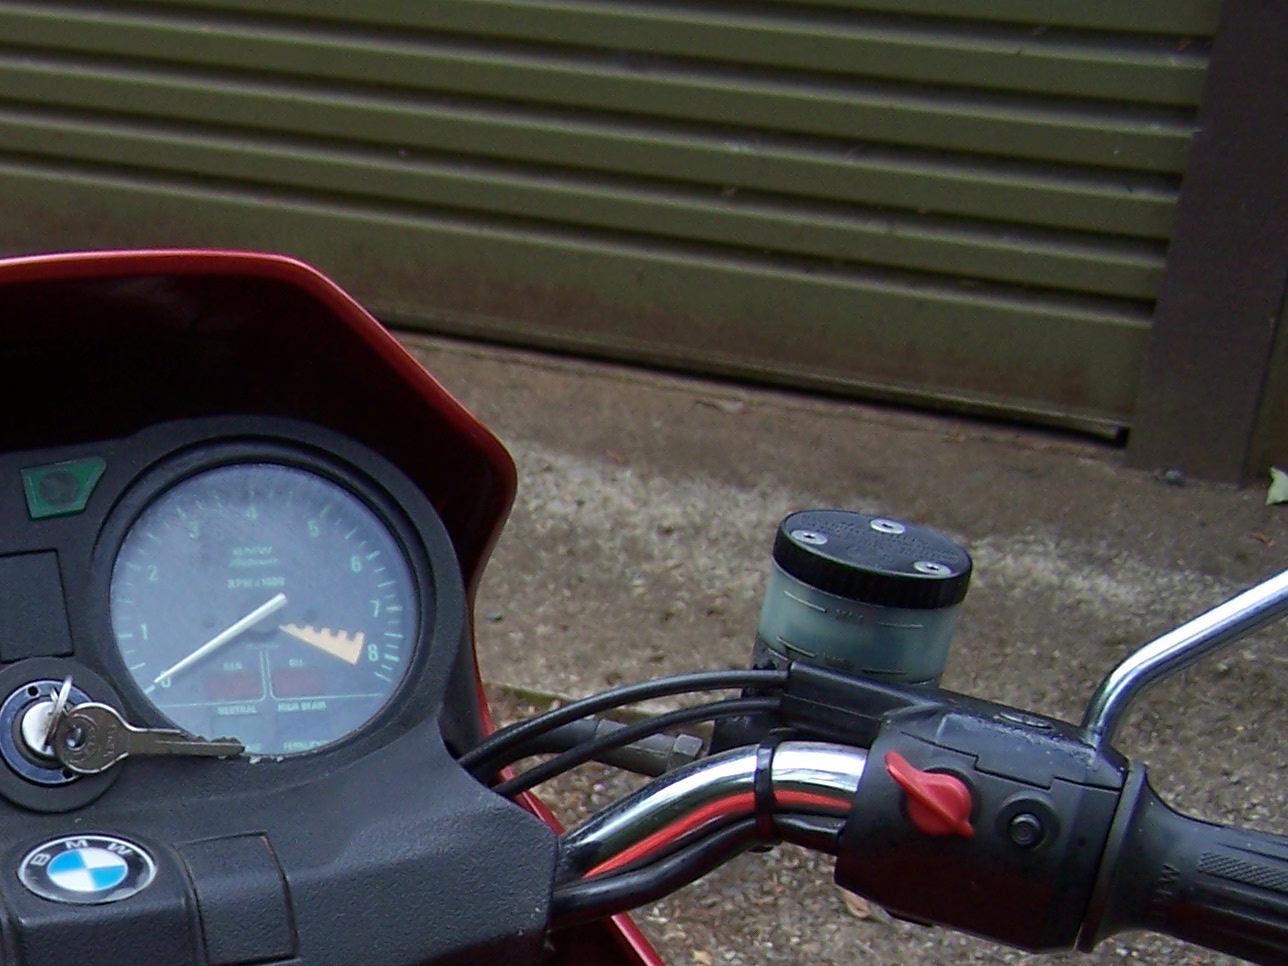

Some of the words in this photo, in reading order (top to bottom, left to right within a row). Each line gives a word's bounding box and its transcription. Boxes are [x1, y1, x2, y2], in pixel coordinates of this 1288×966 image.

[189, 520, 201, 539] 3
[308, 520, 320, 538] 5
[351, 555, 362, 572] 6
[148, 565, 159, 581] 2
[370, 600, 381, 617] 7
[140, 624, 149, 641] 1
[368, 644, 379, 662] 8
[30, 839, 134, 867] BMW
